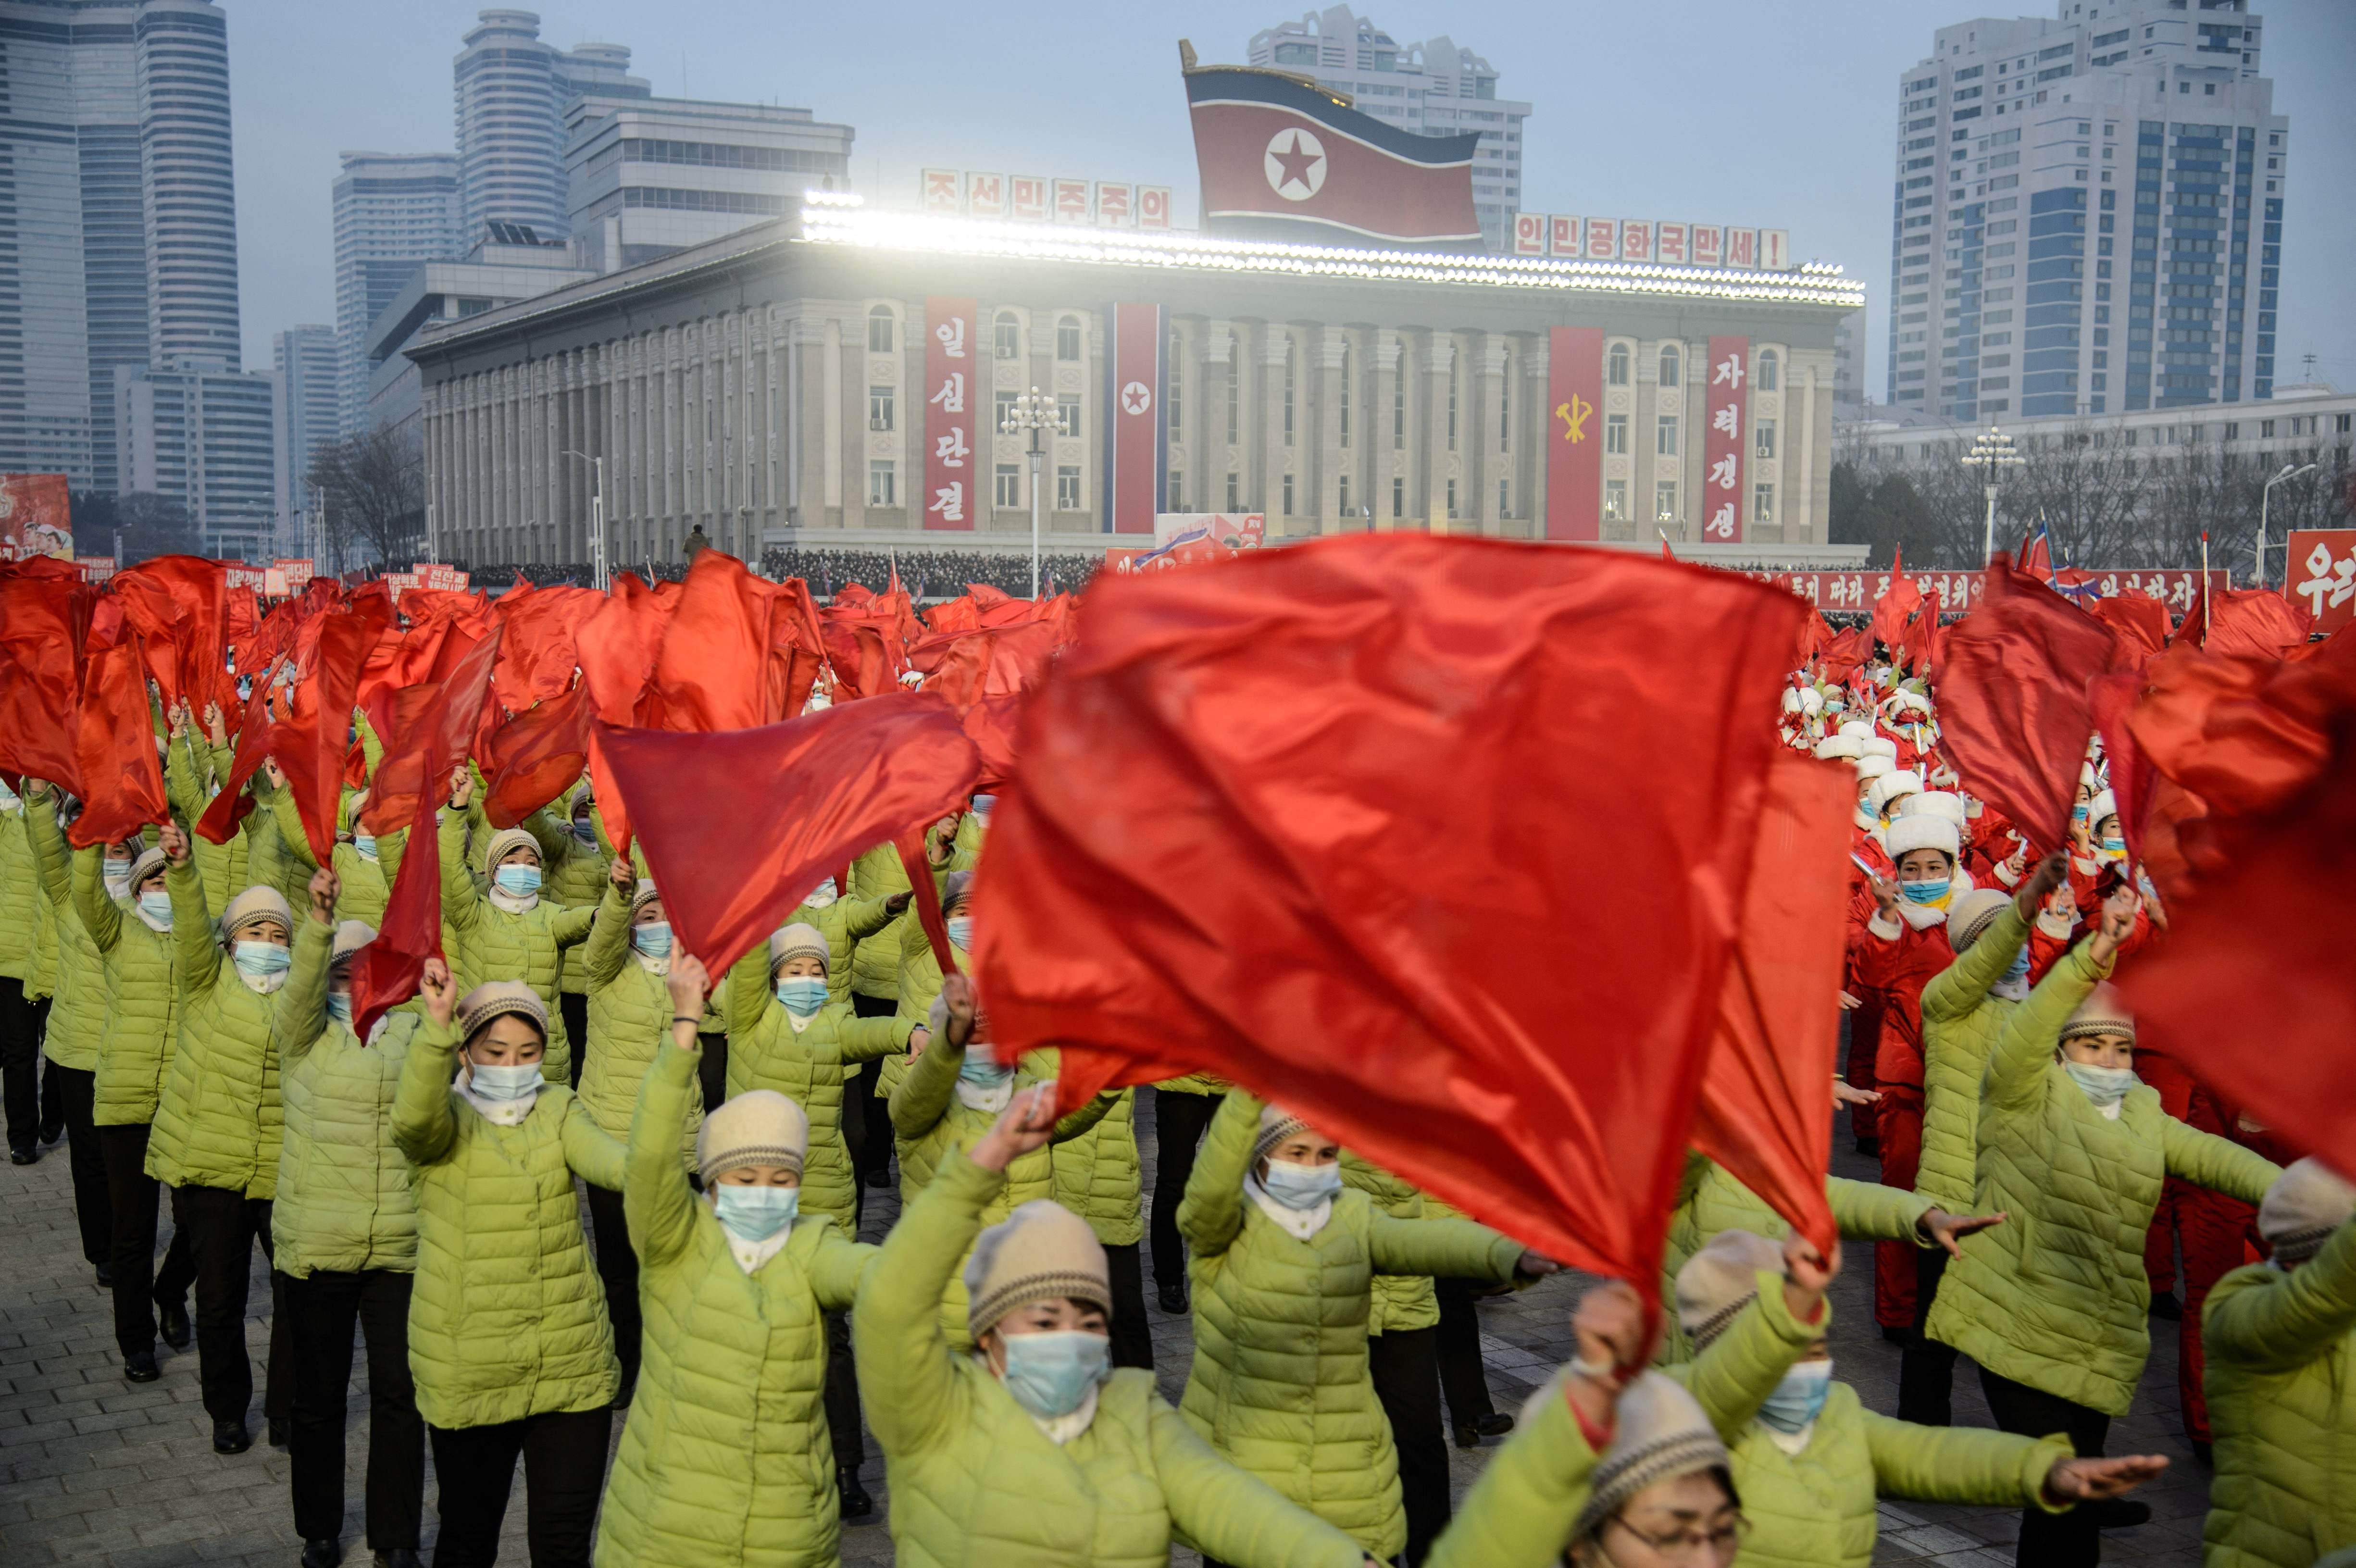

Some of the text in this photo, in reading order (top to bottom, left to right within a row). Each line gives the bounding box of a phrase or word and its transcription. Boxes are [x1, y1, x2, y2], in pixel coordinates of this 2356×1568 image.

[928, 174, 1168, 227] 조선민주주의
[929, 317, 970, 521] 일심단결
[1706, 353, 1744, 538] 자력갱생
[1830, 574, 1864, 607] 따라
